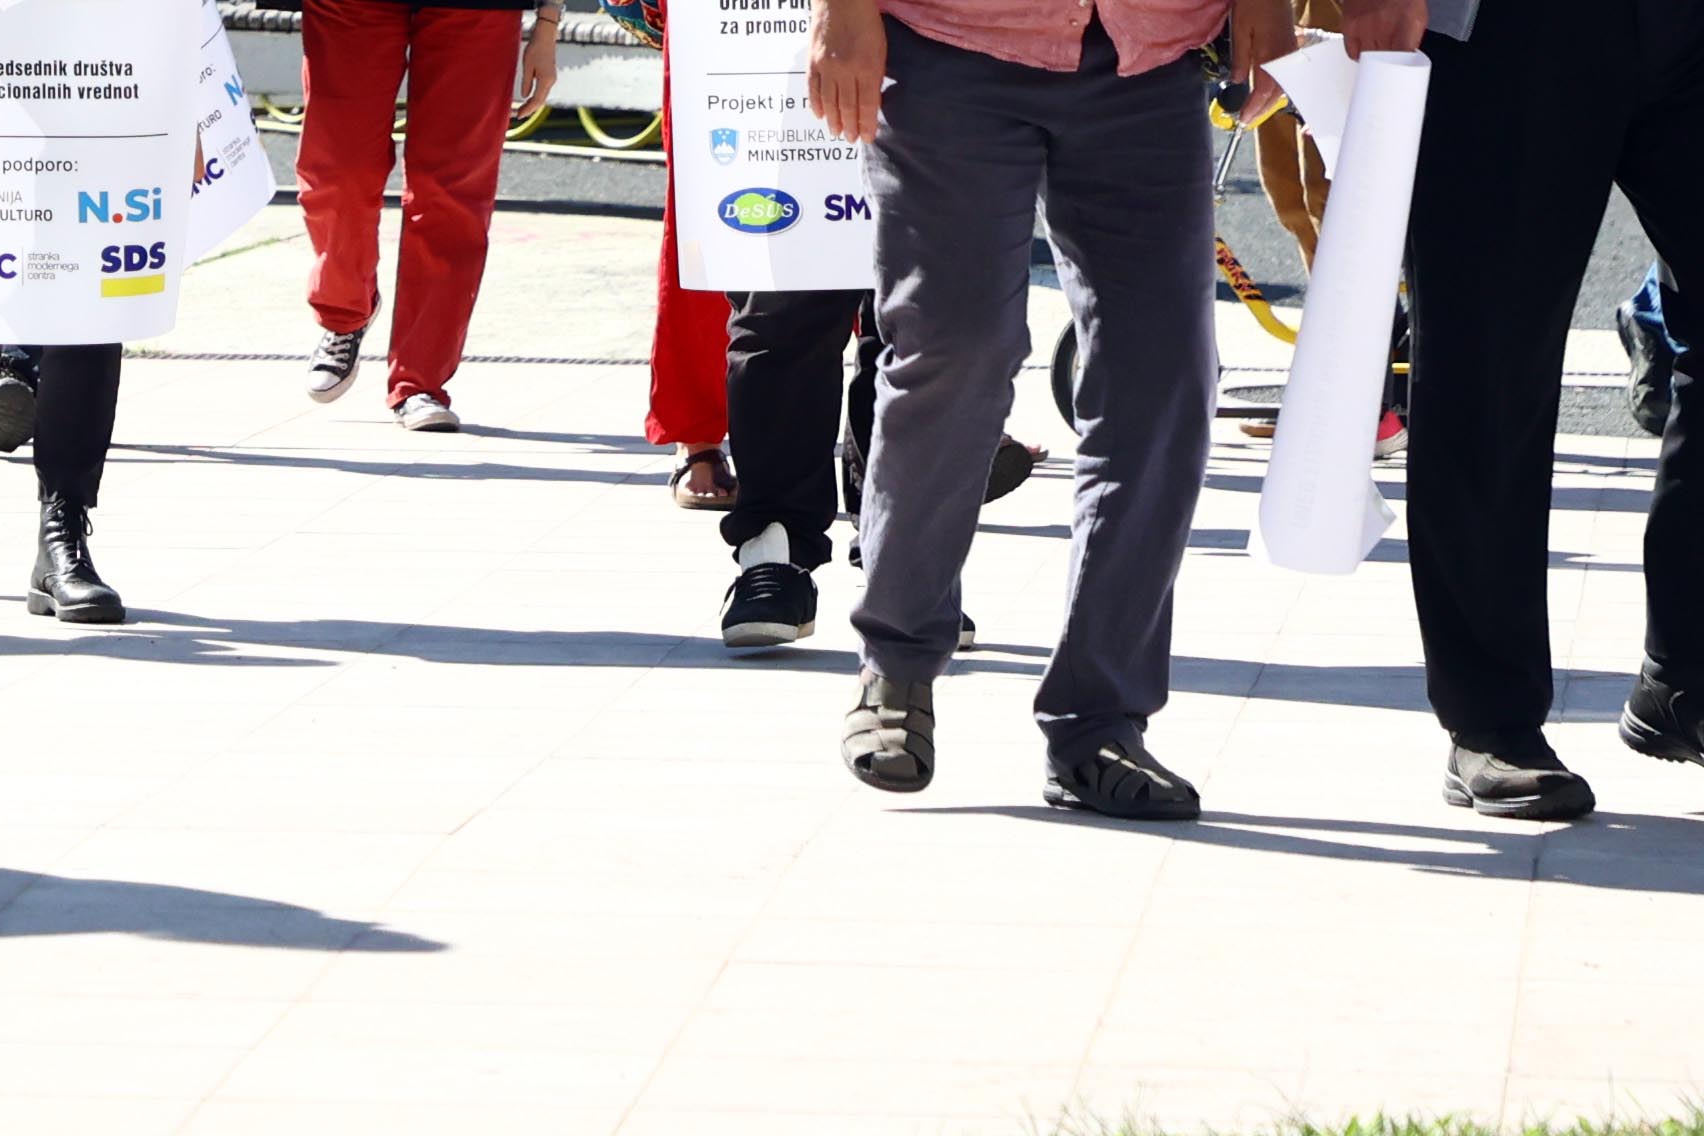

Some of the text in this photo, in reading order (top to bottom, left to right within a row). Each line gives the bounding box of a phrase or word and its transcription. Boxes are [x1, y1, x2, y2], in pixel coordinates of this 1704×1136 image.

[720, 18, 812, 36] za promoc
[74, 60, 132, 76] društva
[78, 84, 138, 99] vrednot
[708, 95, 773, 113] Projekt
[780, 95, 795, 113] je
[748, 129, 825, 143] REPUBLIKA
[748, 148, 841, 162] MINISTRSTVO
[3, 158, 78, 175] podporo:
[77, 187, 161, 224] N.Si
[824, 194, 872, 221] SM
[101, 242, 166, 274] SDS
